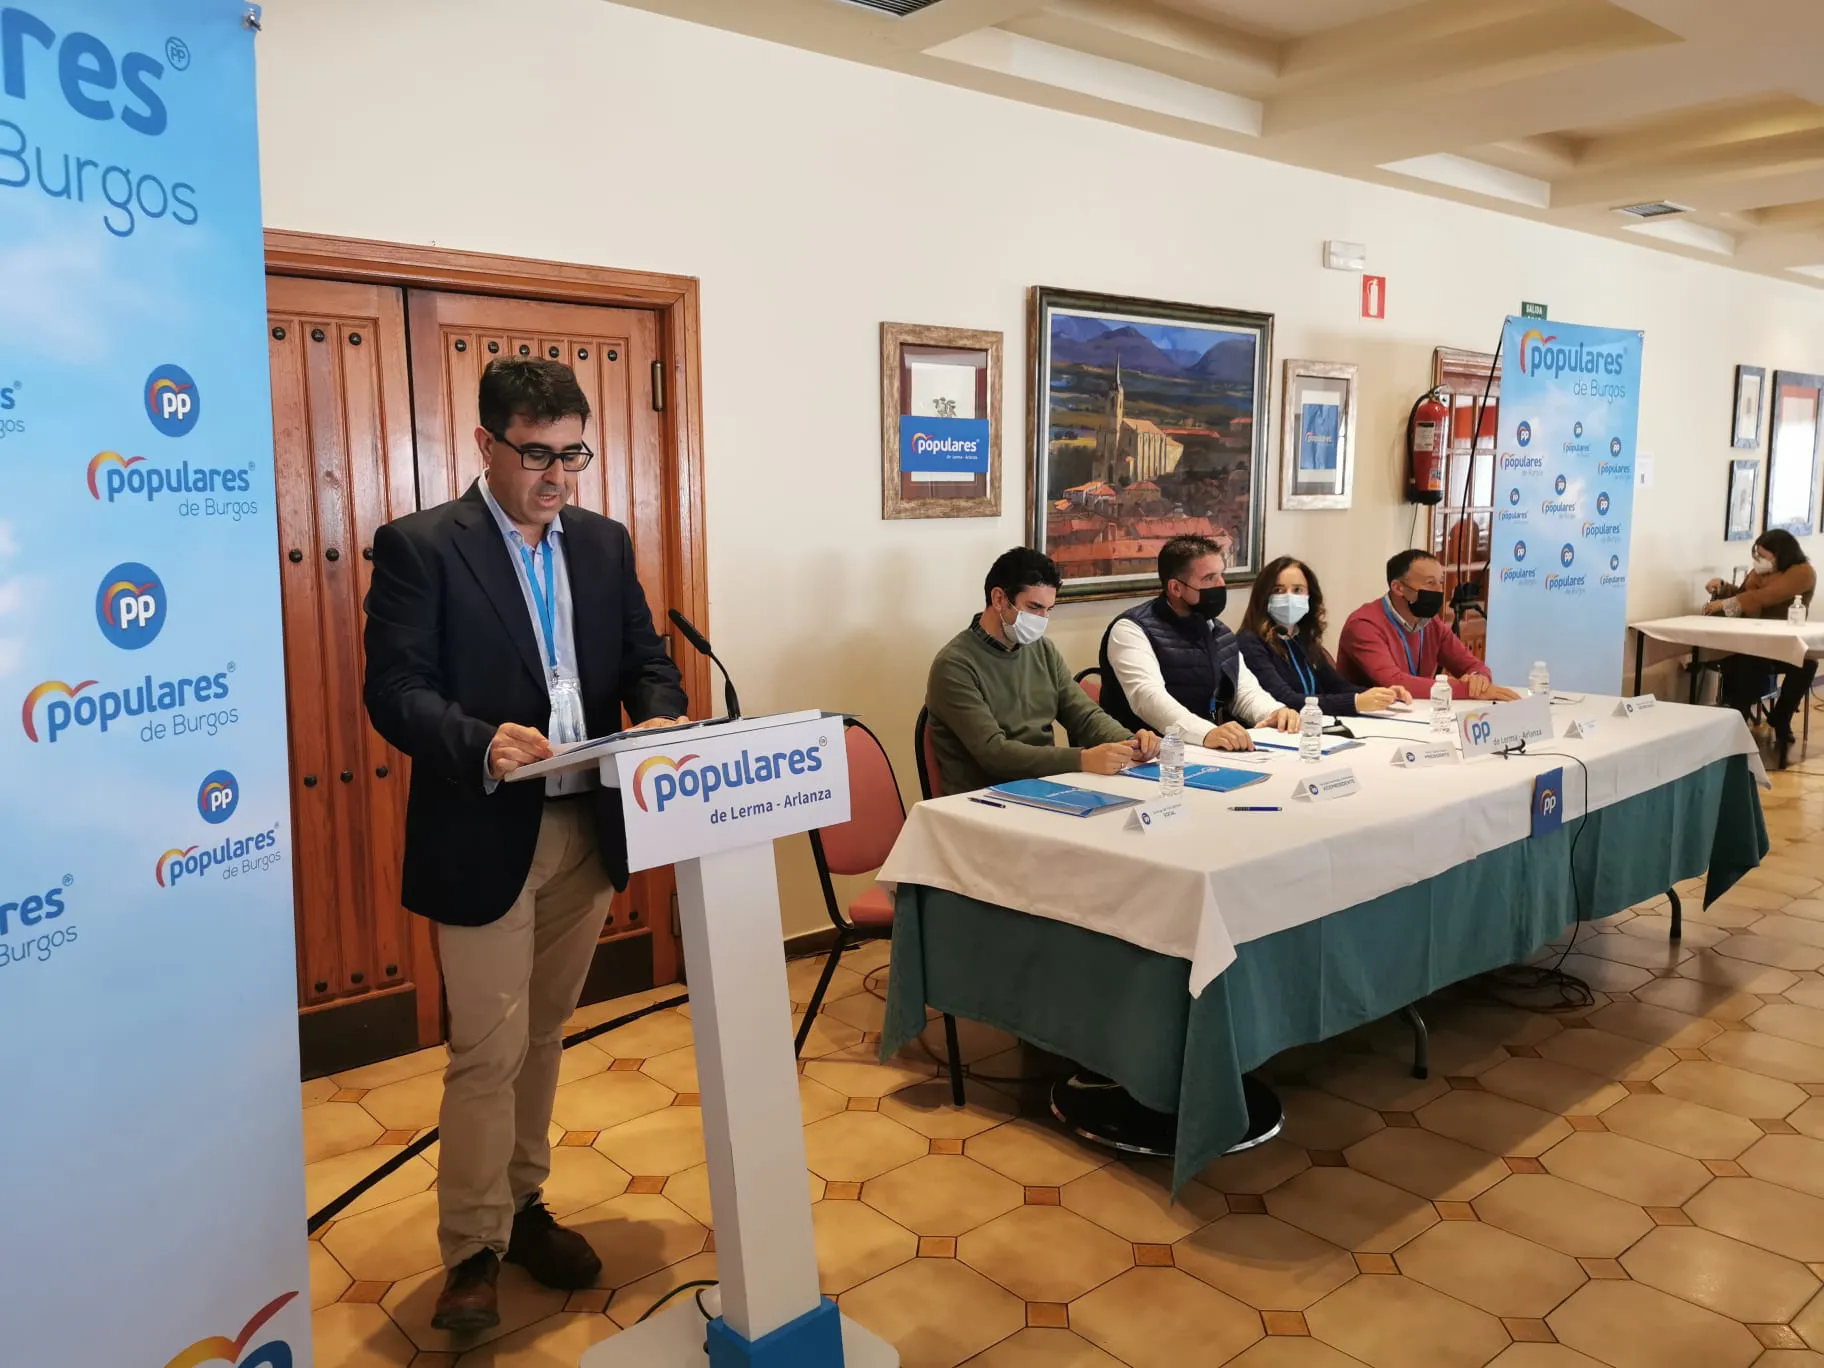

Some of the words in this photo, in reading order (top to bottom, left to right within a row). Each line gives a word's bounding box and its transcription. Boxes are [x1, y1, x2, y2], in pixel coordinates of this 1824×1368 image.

[2, 7, 167, 136] res
[1530, 342, 1624, 379] populares
[1573, 378, 1588, 396] de
[1590, 379, 1626, 404] Burgos
[918, 436, 977, 455] populares
[1504, 456, 1542, 470] populares
[107, 461, 250, 502] populares
[178, 499, 200, 517] de
[205, 498, 258, 521] Burgos
[1585, 523, 1619, 539] populares
[1549, 574, 1585, 591] populares
[48, 672, 229, 742] populares
[140, 719, 166, 742] de
[173, 708, 239, 736] Burgos
[654, 746, 822, 812] populares
[710, 808, 728, 824] de
[731, 799, 774, 820] Lerma
[784, 788, 832, 809] Arlanza
[169, 828, 276, 886] populares
[222, 863, 239, 880] de
[242, 850, 281, 871] Burgos
